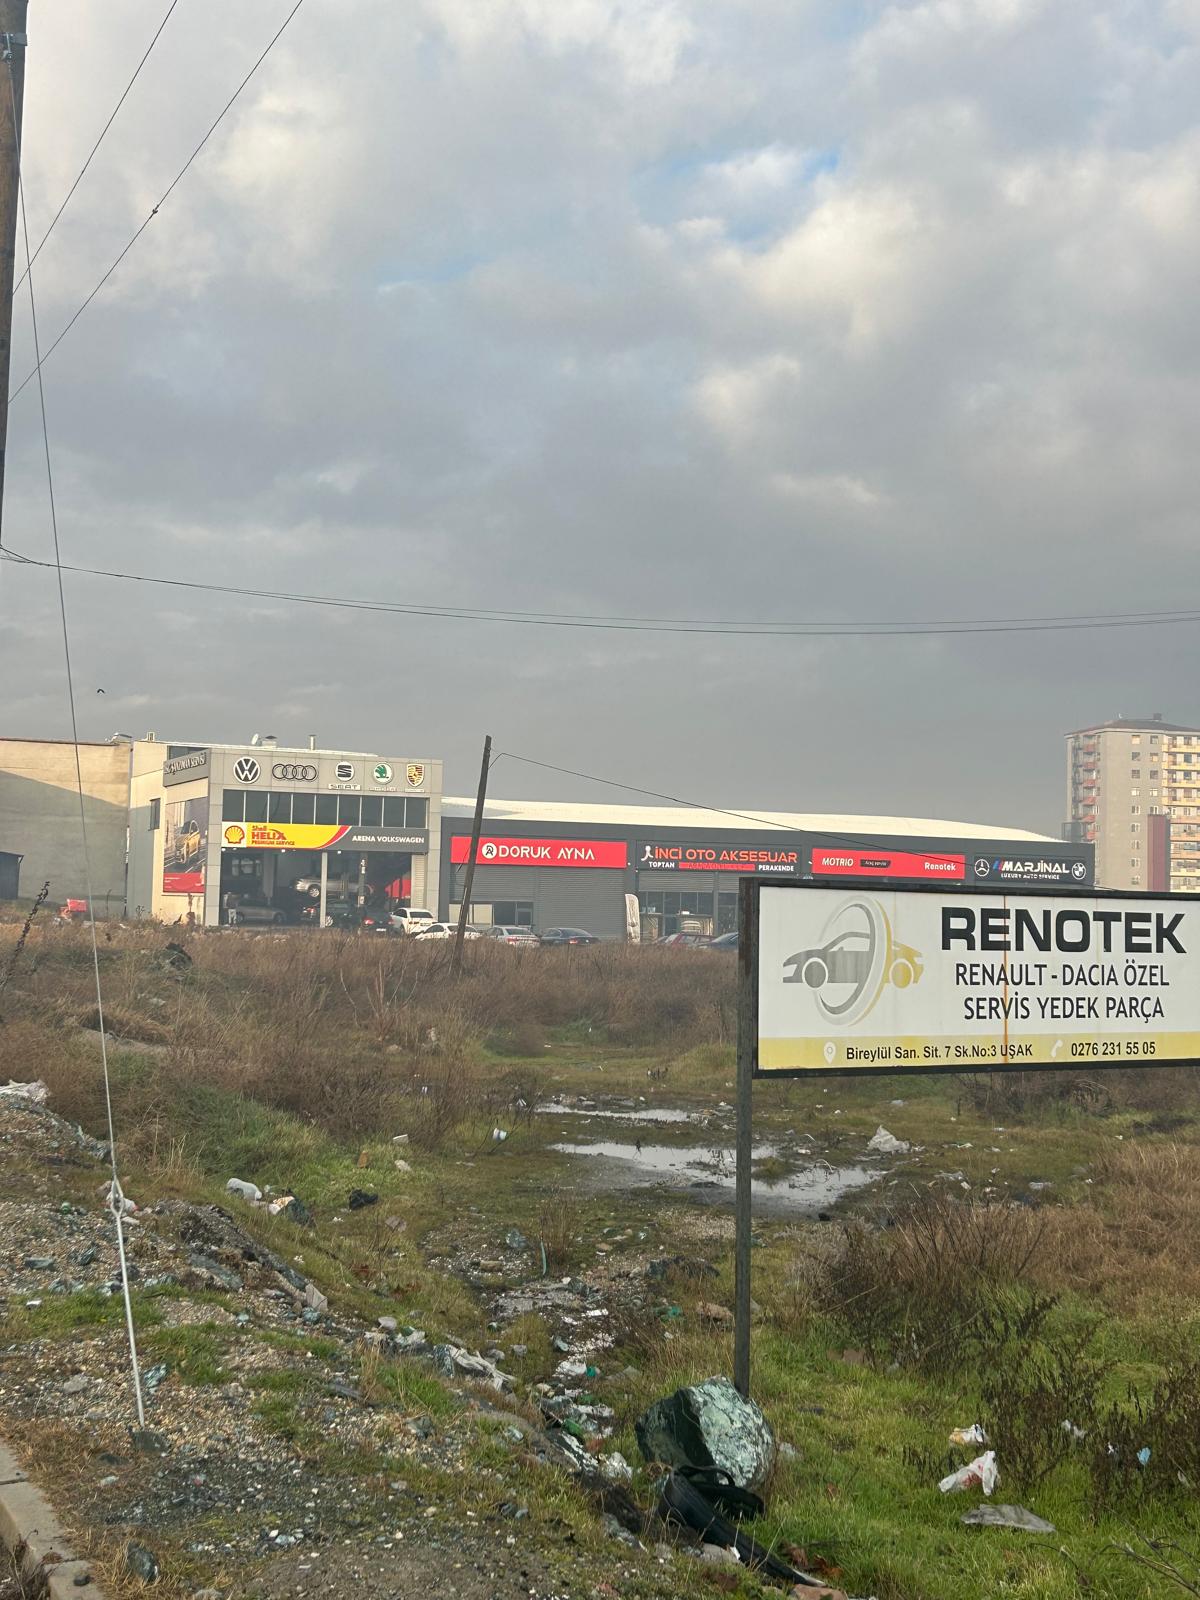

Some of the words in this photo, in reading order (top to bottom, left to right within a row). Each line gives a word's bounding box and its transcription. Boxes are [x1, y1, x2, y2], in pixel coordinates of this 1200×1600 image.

[251, 830, 287, 841] HELIX
[498, 845, 551, 859] DORUK
[557, 847, 595, 860] AYNA
[685, 849, 716, 861] OTO
[719, 850, 797, 863] AKSESUAR
[758, 864, 795, 872] PERAKENDE
[822, 857, 854, 867] MOTRIO
[941, 907, 1187, 953] RENOTEK
[955, 963, 1047, 986] RENAULT
[1062, 964, 1118, 986] DACIA
[1123, 959, 1170, 986] ÖZEL
[964, 992, 1030, 1020] SERVİS
[1037, 997, 1099, 1019] YEDEK
[1106, 996, 1165, 1023] PARÇA
[846, 1046, 891, 1062] Bireylül
[894, 1046, 920, 1059] San.
[923, 1045, 941, 1058] Sit.
[945, 1045, 951, 1058] 7
[1000, 1044, 1033, 1060] UŞAK
[1071, 1042, 1099, 1056] 0276
[1101, 1041, 1122, 1056] 231
[1126, 1041, 1139, 1055] 55
[1142, 1041, 1156, 1055] 05
